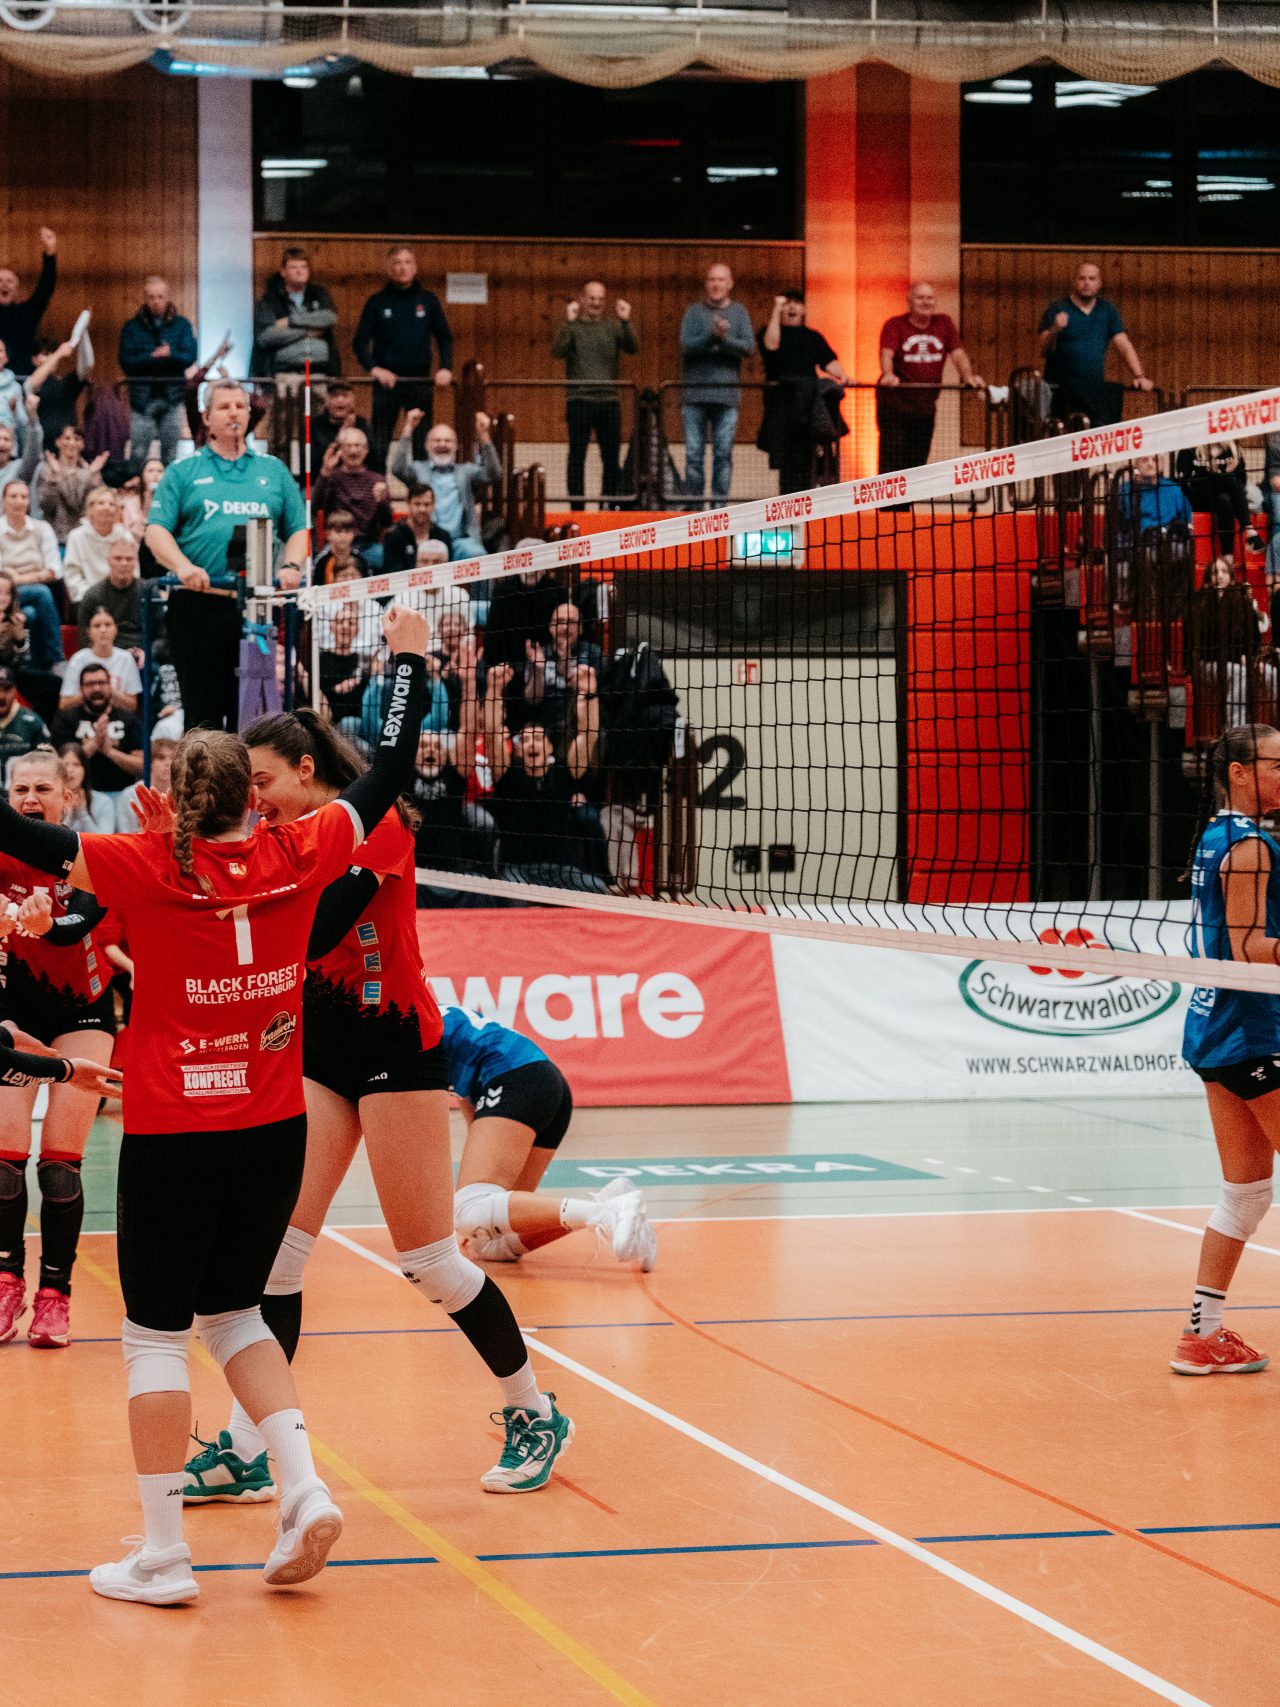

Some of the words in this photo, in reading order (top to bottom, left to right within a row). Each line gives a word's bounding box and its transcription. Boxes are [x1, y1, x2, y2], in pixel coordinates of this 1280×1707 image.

[1207, 395, 1280, 434] Lexwar
[1071, 425, 1144, 462] Lexware
[953, 452, 1015, 485] Lexware
[853, 475, 907, 505] Lexware
[222, 501, 269, 515] DEKRA
[765, 495, 813, 522] Lexware
[687, 512, 730, 537] Lexware
[558, 539, 592, 561] Lexware
[619, 526, 657, 550] Lexware
[453, 561, 481, 580] Lexware
[503, 550, 534, 571] Lexware
[380, 663, 413, 748] Lexware
[698, 734, 746, 808] 2
[215, 903, 254, 966] 1
[185, 977, 242, 994] BLACK
[247, 962, 299, 991] FOREST
[187, 993, 240, 1005] VOLLEYS
[243, 978, 297, 1001] OFFENBURG
[971, 971, 1170, 1021] Schwarzwaldhof
[426, 972, 705, 1040] ware
[199, 1032, 249, 1049] E-WERK
[966, 1053, 1193, 1075] WWW.SCHWARZWALDHOF.D
[183, 1069, 247, 1090] KONPRECHT
[576, 1160, 880, 1179] DEKRA
[294, 1423, 306, 1431] JA
[167, 1488, 183, 1497] JA
